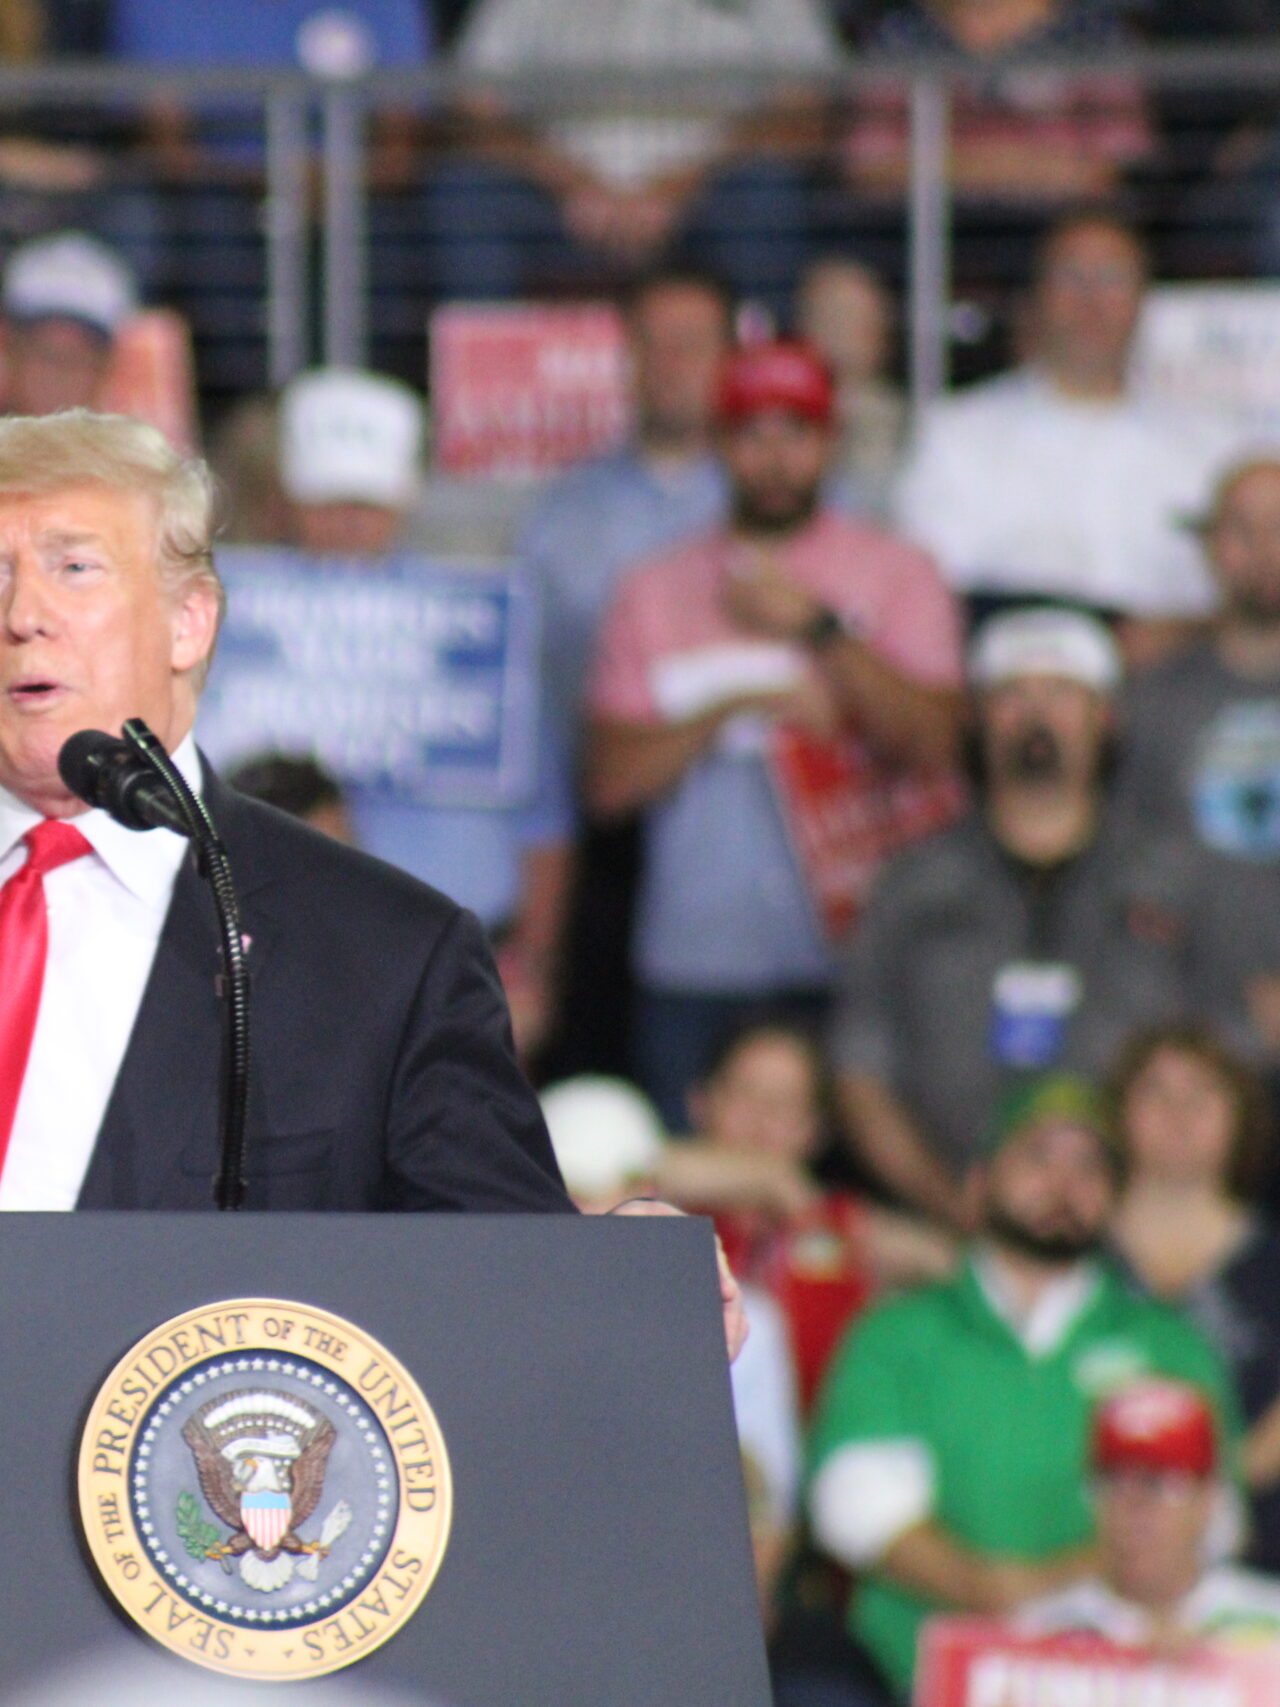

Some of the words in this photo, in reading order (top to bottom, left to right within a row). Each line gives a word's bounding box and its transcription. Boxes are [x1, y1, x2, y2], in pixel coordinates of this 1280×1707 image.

[263, 1317, 294, 1339] OF
[303, 1326, 349, 1361] THE
[93, 1313, 249, 1477] PRESIDENT
[358, 1360, 436, 1513] UNITED
[98, 1494, 123, 1543] THE
[114, 1552, 141, 1580] OF
[145, 1580, 236, 1660] SEAL
[303, 1550, 422, 1661] STATES
